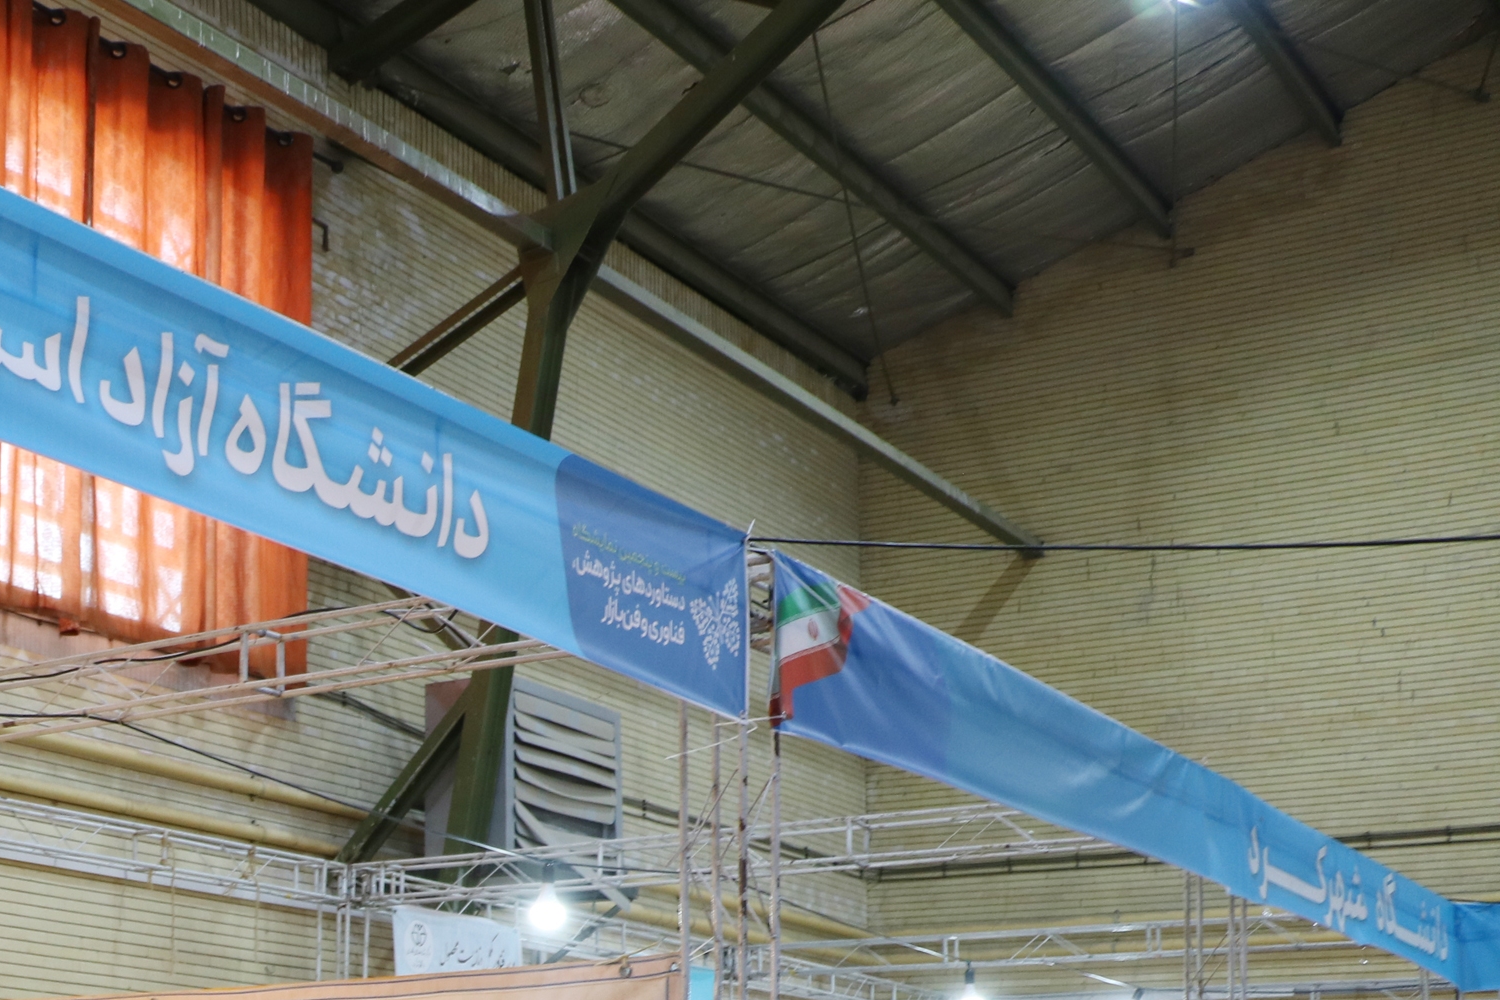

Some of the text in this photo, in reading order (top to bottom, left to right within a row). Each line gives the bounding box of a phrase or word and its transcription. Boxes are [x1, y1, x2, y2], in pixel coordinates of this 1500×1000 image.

[100, 331, 230, 478] آزاد
[224, 380, 491, 562] دانشگاه
[622, 570, 686, 611] دستاوردهای
[648, 619, 686, 647] فناوری
[1375, 872, 1448, 961] دانشگاه
